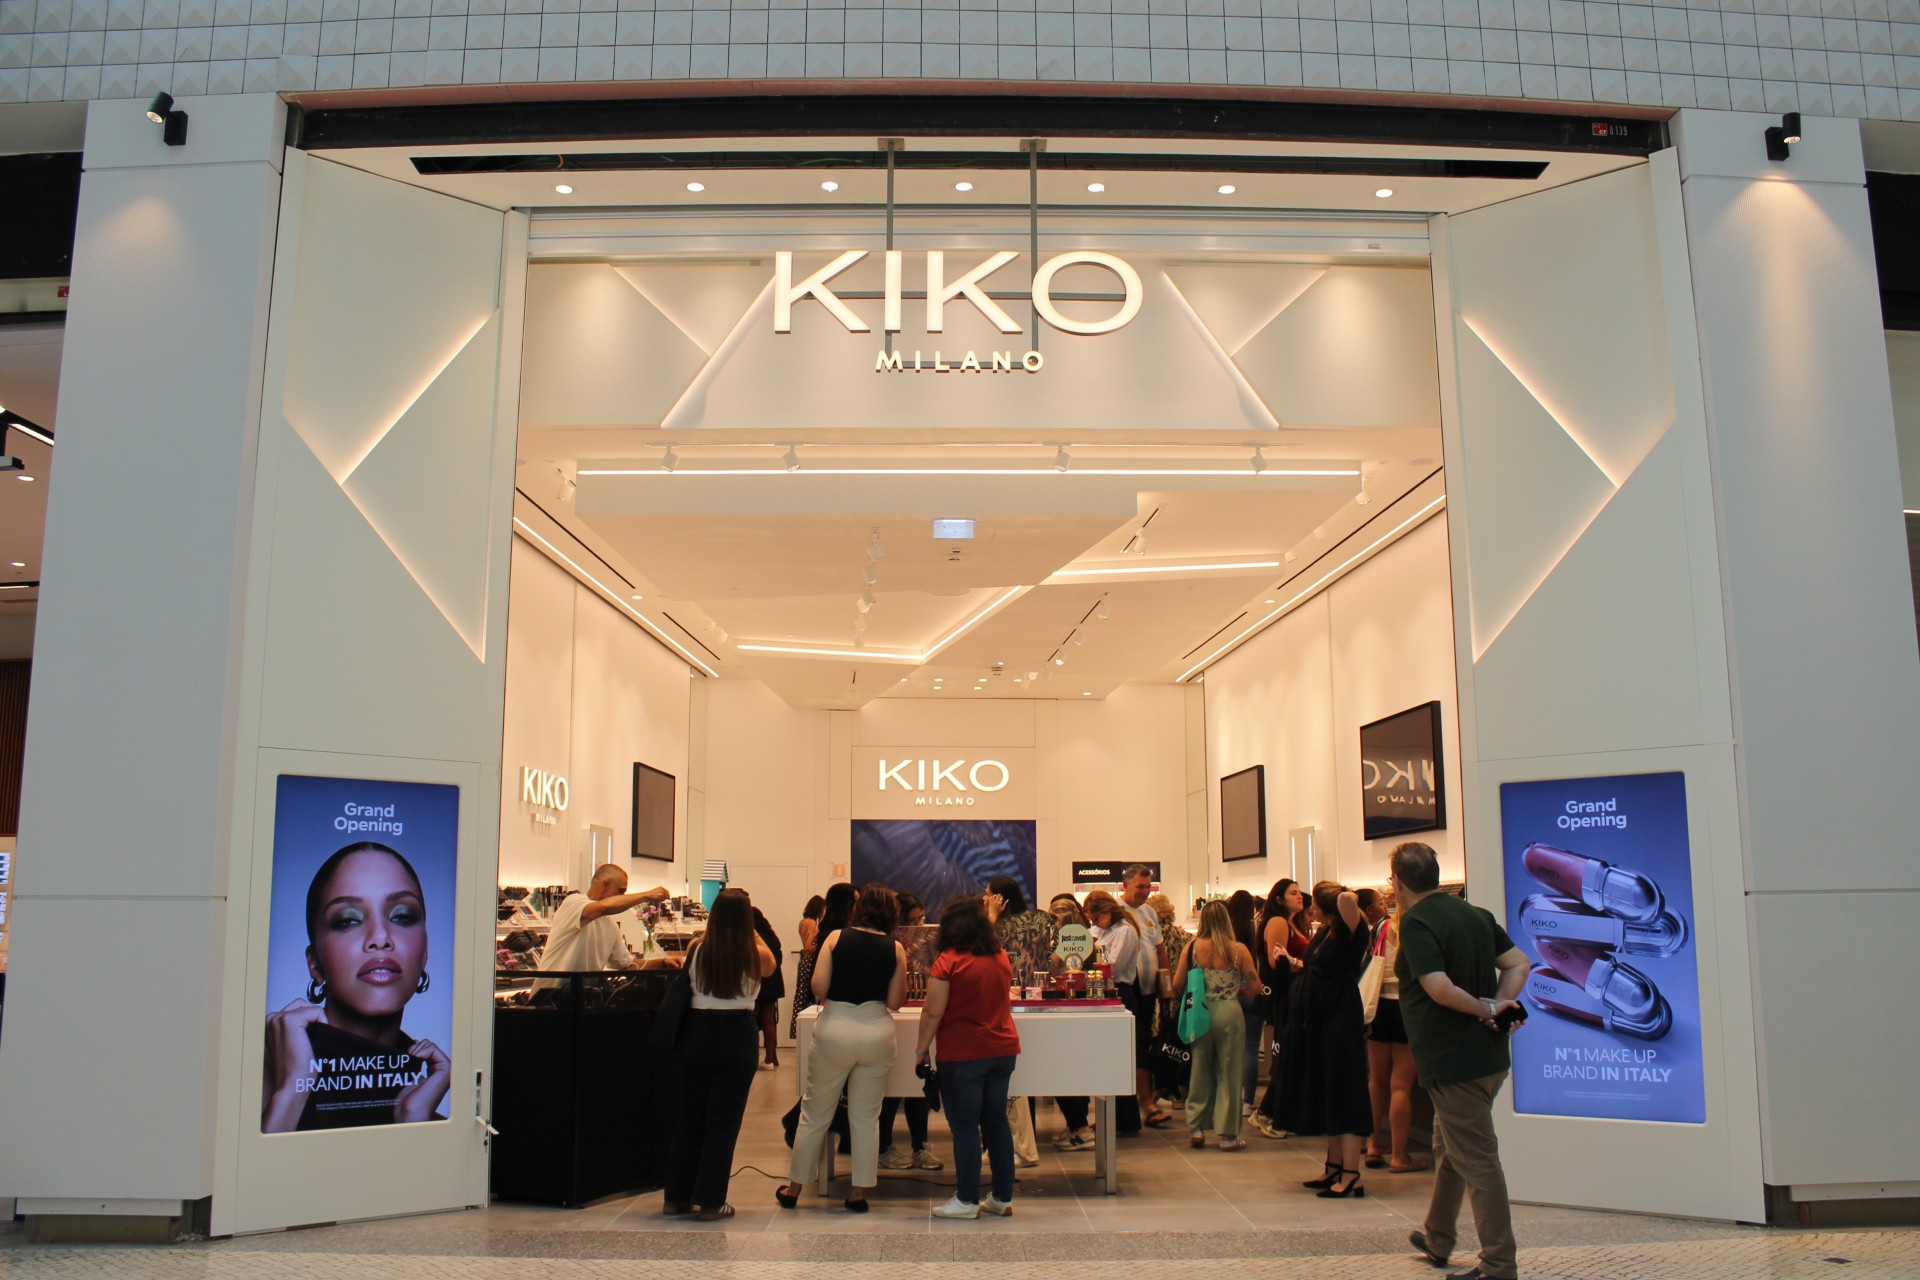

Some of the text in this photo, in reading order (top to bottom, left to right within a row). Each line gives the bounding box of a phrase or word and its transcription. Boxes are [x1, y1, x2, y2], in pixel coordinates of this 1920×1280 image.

[774, 250, 1143, 336] KIKO
[875, 350, 1044, 373] MILANO
[878, 759, 1010, 792] KIKO
[523, 765, 569, 811] KIKO
[344, 802, 395, 818] Grand
[915, 797, 975, 806] MILANO
[1565, 797, 1617, 814] Grand
[334, 816, 403, 836] Opening
[1556, 812, 1627, 832] Opening
[1078, 868, 1110, 876] ACESSÓRIOS
[1531, 919, 1558, 929] KIKO
[1548, 943, 1570, 961] KIKO
[1533, 981, 1557, 994] KIKO
[1161, 1043, 1191, 1061] KIKO
[1584, 1047, 1631, 1063] MAKE
[1633, 1049, 1657, 1064] UP
[339, 1055, 385, 1071] MAKE
[388, 1054, 410, 1069] UP
[295, 1071, 423, 1093] BRAND IN ITALY
[1543, 1064, 1672, 1083] BRAND IN ITALY
